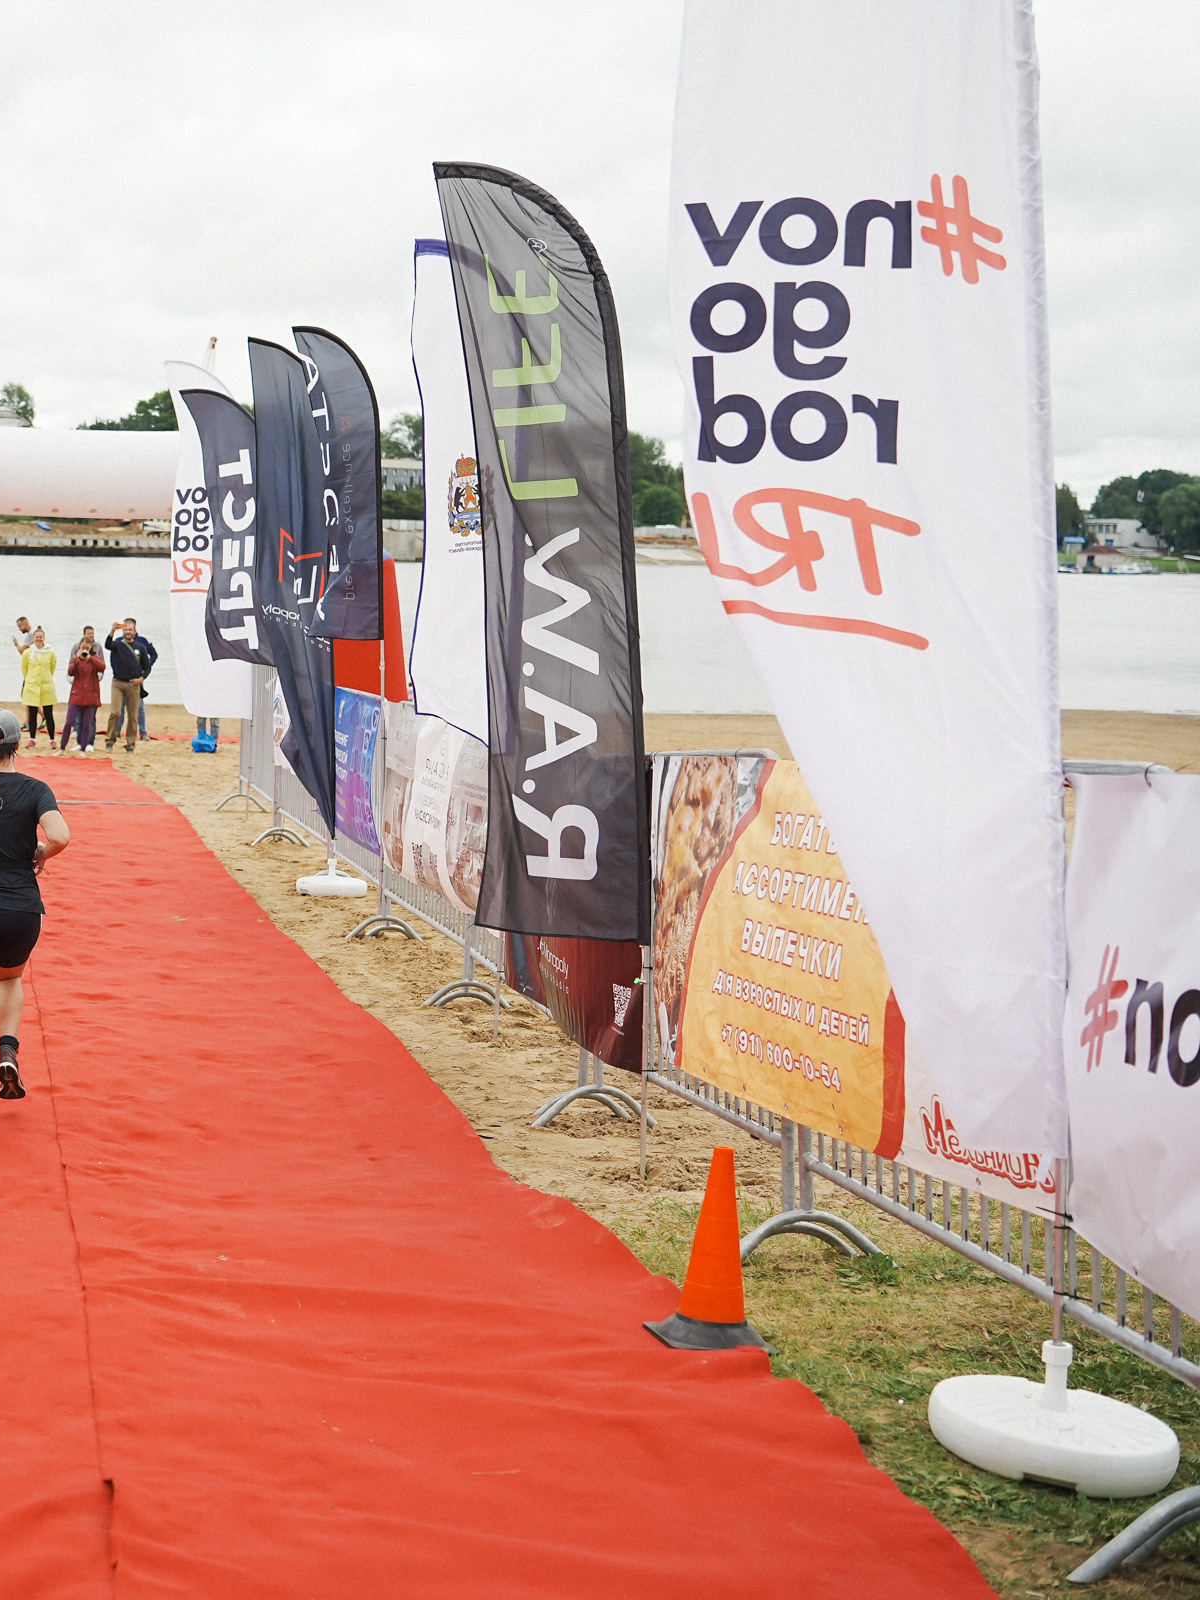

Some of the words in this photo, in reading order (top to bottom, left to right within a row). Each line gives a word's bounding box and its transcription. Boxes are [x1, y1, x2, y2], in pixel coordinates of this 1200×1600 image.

[740, 918, 843, 982] ВЫПЕЧКИ
[804, 1002, 816, 1027] И
[818, 1007, 871, 1047] ДЕТЕЙ
[734, 1028, 764, 1062] (911)
[766, 1040, 842, 1092] 600-10-54
